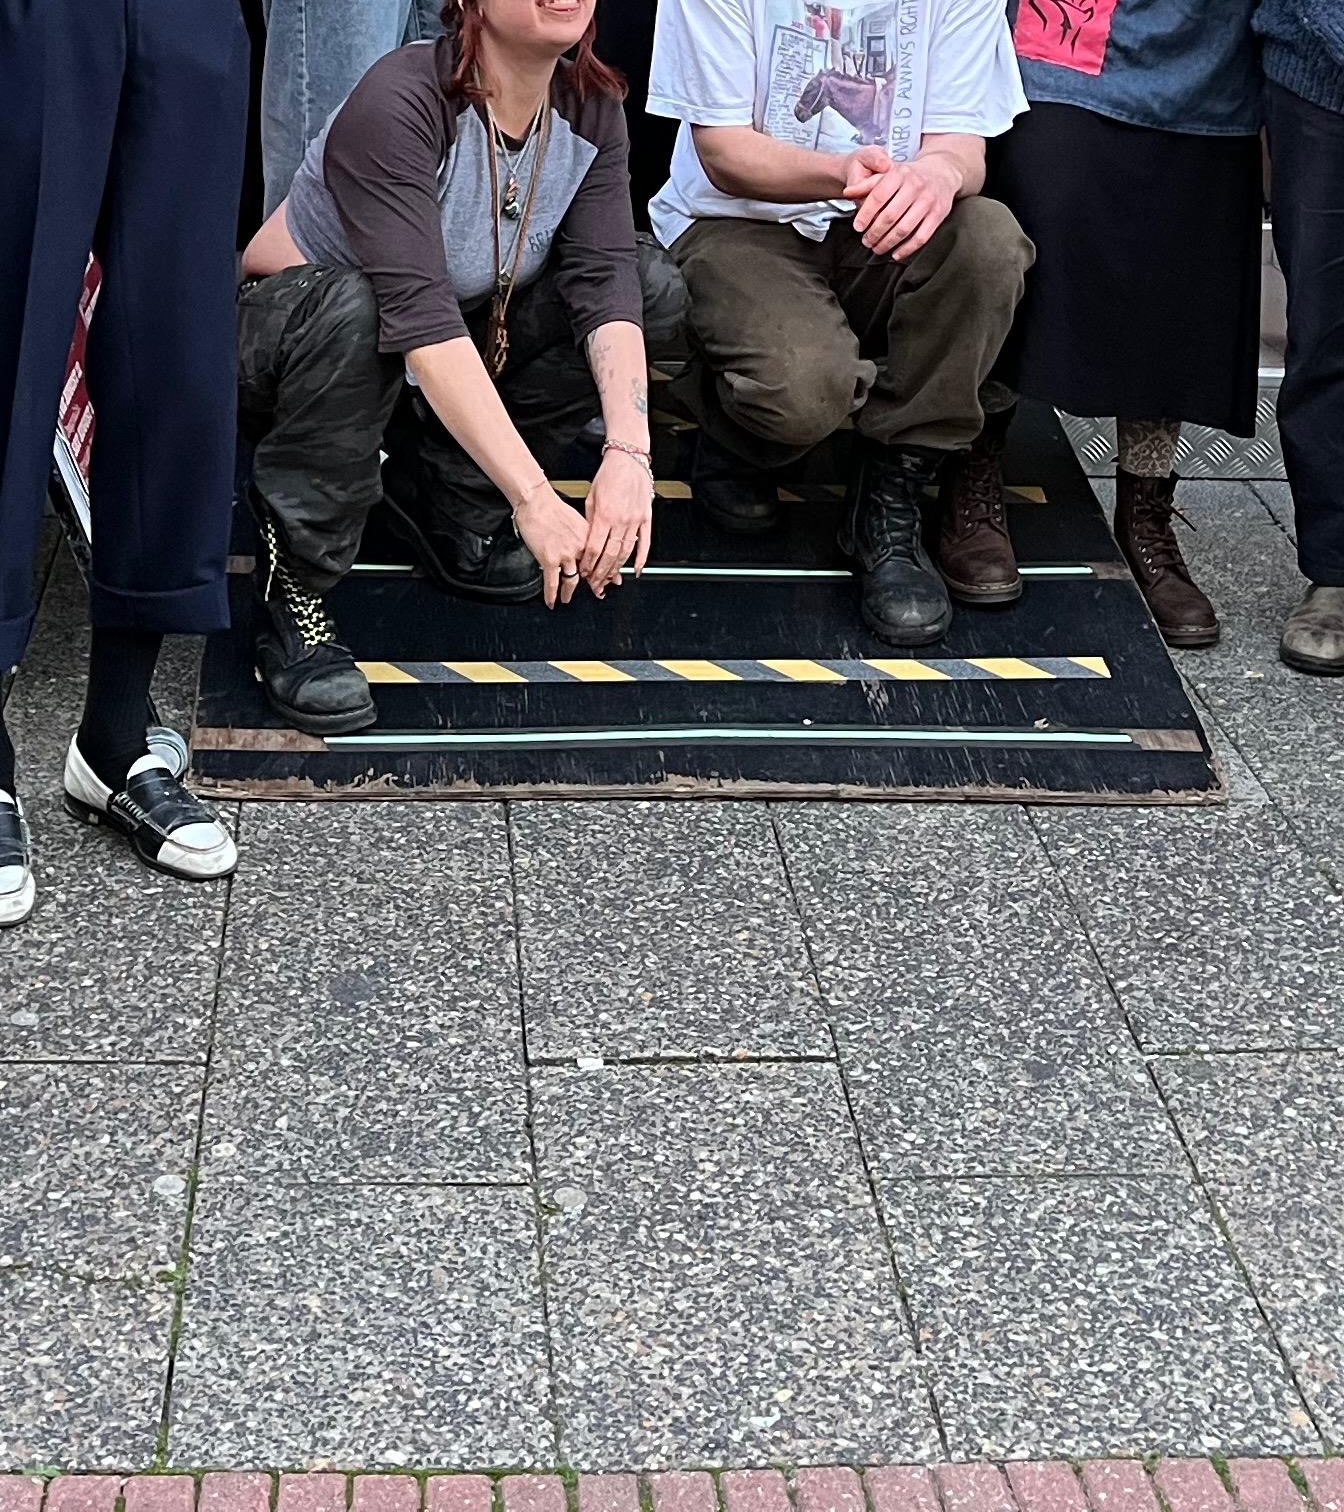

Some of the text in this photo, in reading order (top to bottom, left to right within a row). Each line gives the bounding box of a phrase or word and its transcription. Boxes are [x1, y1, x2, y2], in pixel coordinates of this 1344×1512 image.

[892, 0, 919, 163] OMER IS ALWAYS RIGHT
